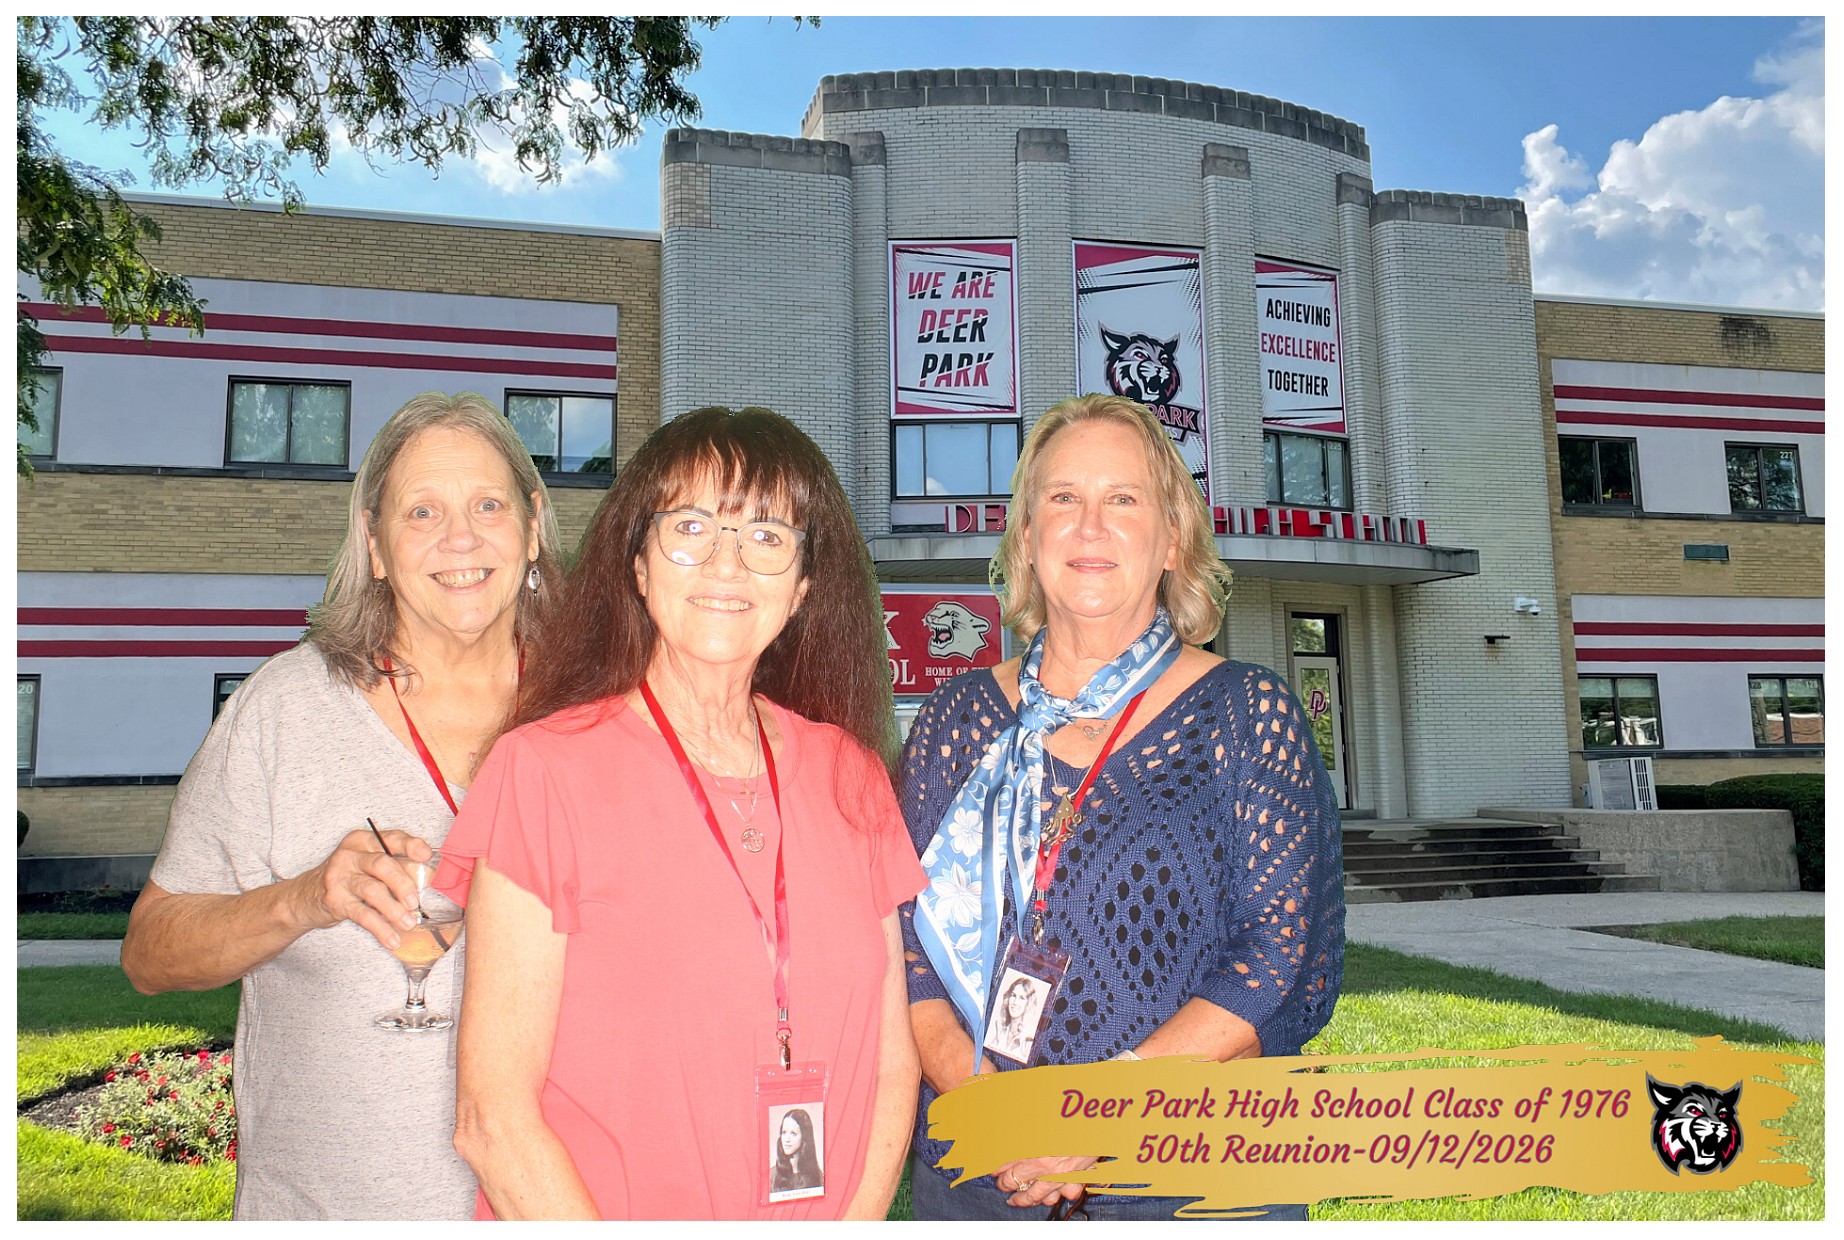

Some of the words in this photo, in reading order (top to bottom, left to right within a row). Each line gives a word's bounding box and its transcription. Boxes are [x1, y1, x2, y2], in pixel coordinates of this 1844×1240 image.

[908, 271, 946, 299] WE
[951, 270, 998, 299] ARE
[917, 308, 988, 343] DEER
[1266, 298, 1331, 328] ACHIEVING
[1261, 332, 1336, 363] EXCELLENCE
[919, 352, 994, 387] PARK
[1267, 369, 1329, 397] TOGETHER
[925, 666, 953, 677] HOME
